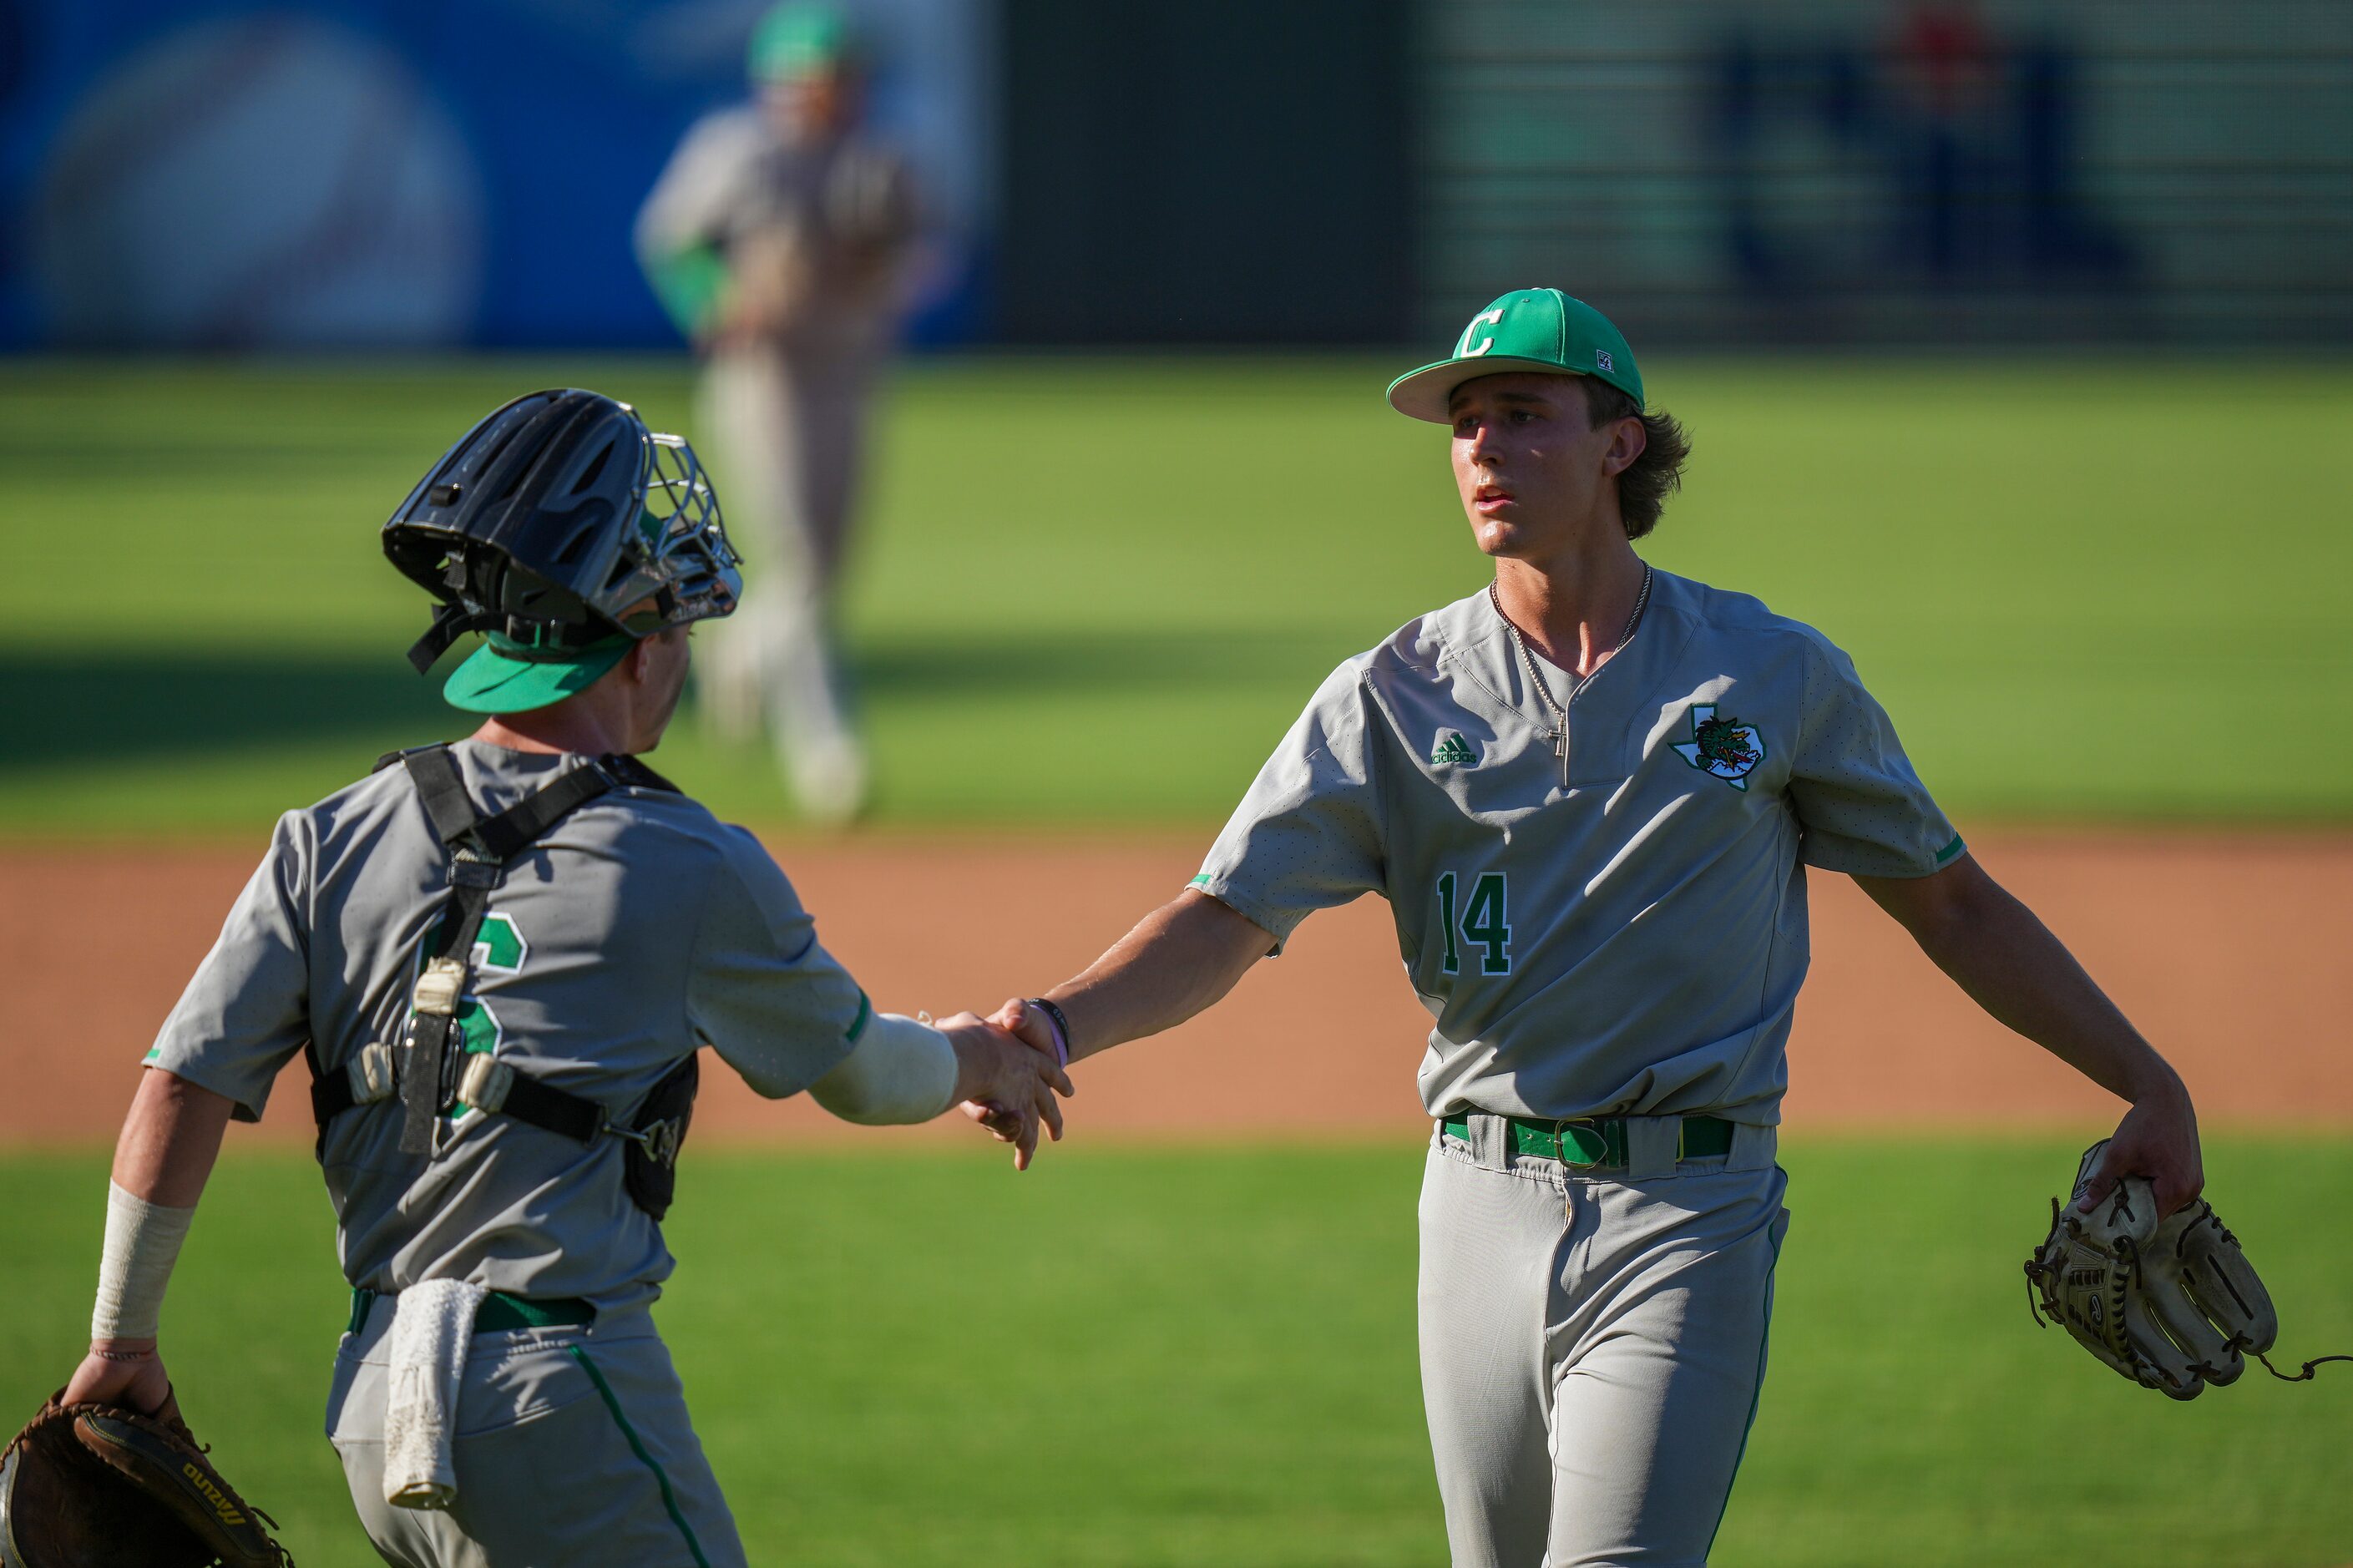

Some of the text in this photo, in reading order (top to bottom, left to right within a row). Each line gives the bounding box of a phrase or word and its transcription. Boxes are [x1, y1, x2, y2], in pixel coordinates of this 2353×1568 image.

[1460, 309, 1505, 358] C
[1431, 750, 1477, 764] adidas
[1436, 871, 1512, 976] 14
